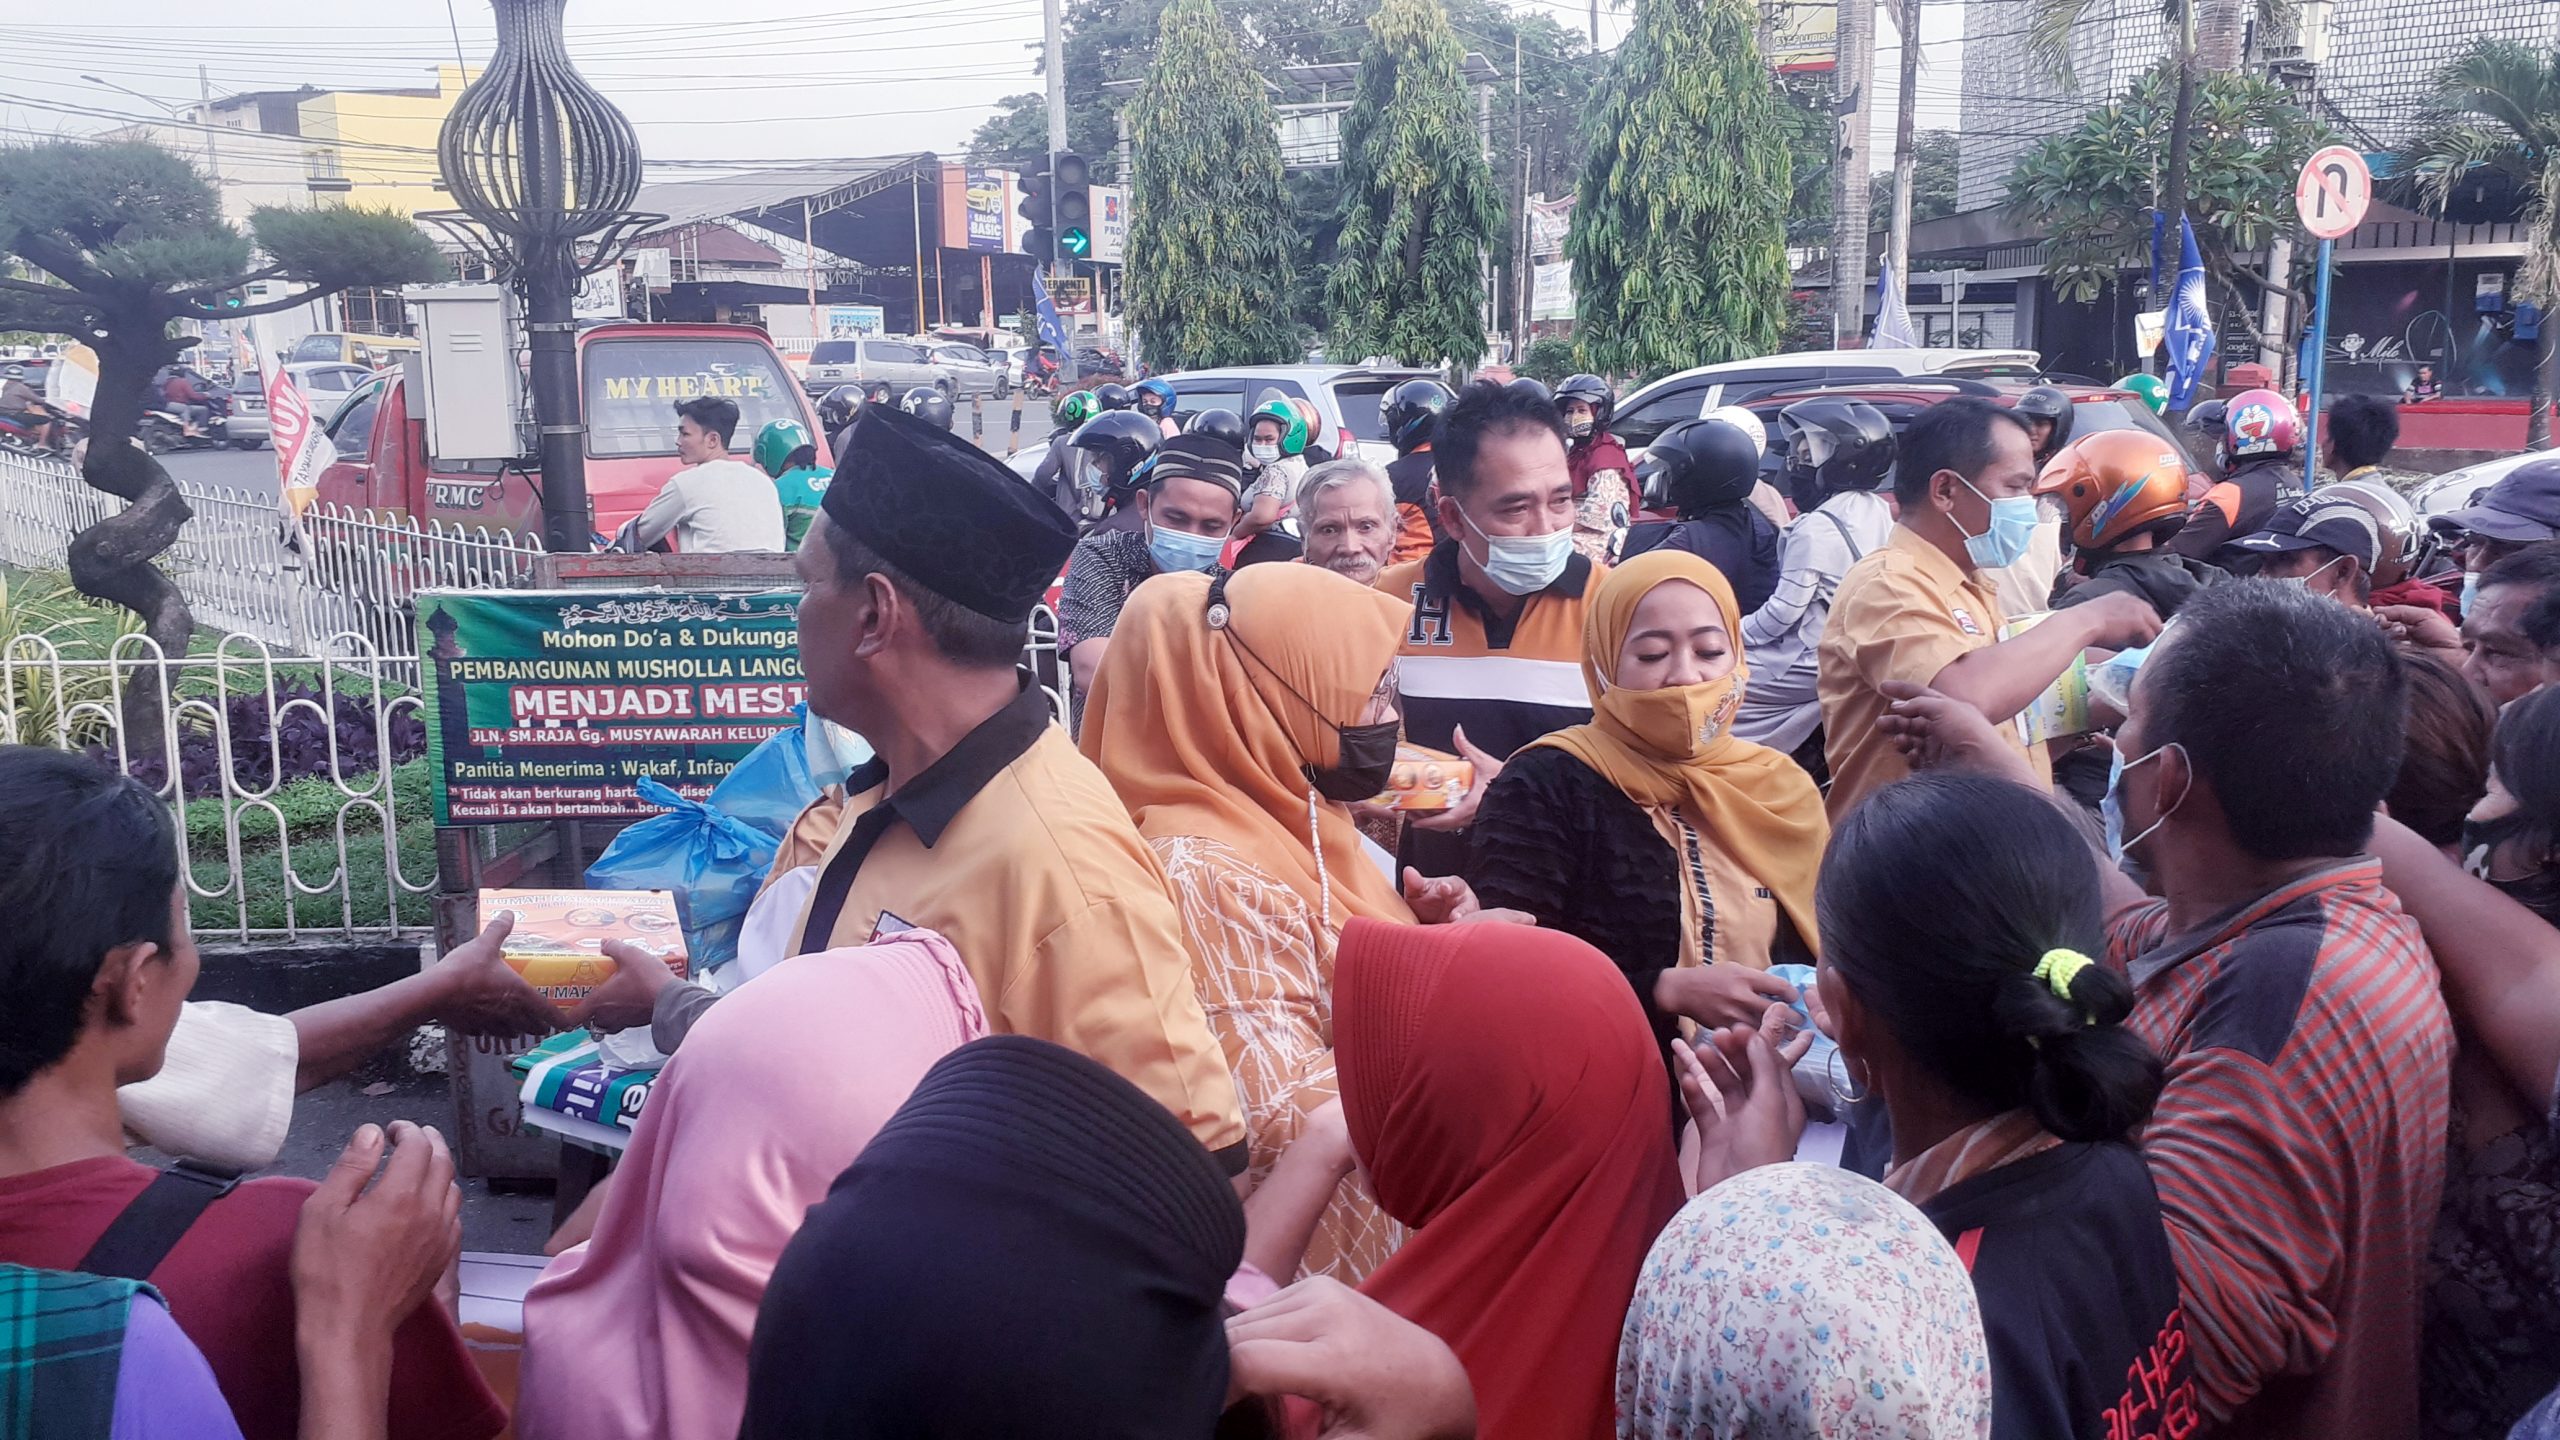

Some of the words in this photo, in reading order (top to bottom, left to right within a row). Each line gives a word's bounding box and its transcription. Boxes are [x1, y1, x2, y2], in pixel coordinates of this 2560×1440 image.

[974, 214, 997, 223] SALON
[970, 222, 1002, 237] BASIC
[1104, 226, 1122, 236] PRO
[605, 377, 651, 399] MY
[656, 375, 762, 398] HEART
[435, 485, 484, 507] RMC
[1407, 582, 1453, 645] H
[543, 630, 616, 648] Mohon
[679, 628, 696, 646] &
[703, 628, 799, 648] Dukunga
[451, 660, 610, 680] PEMBANGUNAN
[618, 658, 733, 678] MUSHOLLA
[514, 688, 691, 716] MENJADI
[704, 685, 808, 715] MESJ
[472, 730, 505, 743] JLN.
[509, 730, 575, 742] SM.RAJA
[579, 729, 604, 744] Gg.
[610, 728, 722, 741] MUSYAWARAH
[728, 727, 783, 740] KELUR
[455, 761, 514, 778] Panitia
[520, 760, 604, 777] Menerima
[621, 759, 682, 778] Wakaf,
[461, 788, 497, 800] Tidak
[500, 788, 531, 800] akan
[535, 787, 602, 801] berkurang
[680, 785, 713, 798] dised
[452, 804, 499, 816] Kecuali
[503, 804, 517, 815] Ia
[521, 804, 551, 815] akan
[554, 985, 593, 999] MAK
